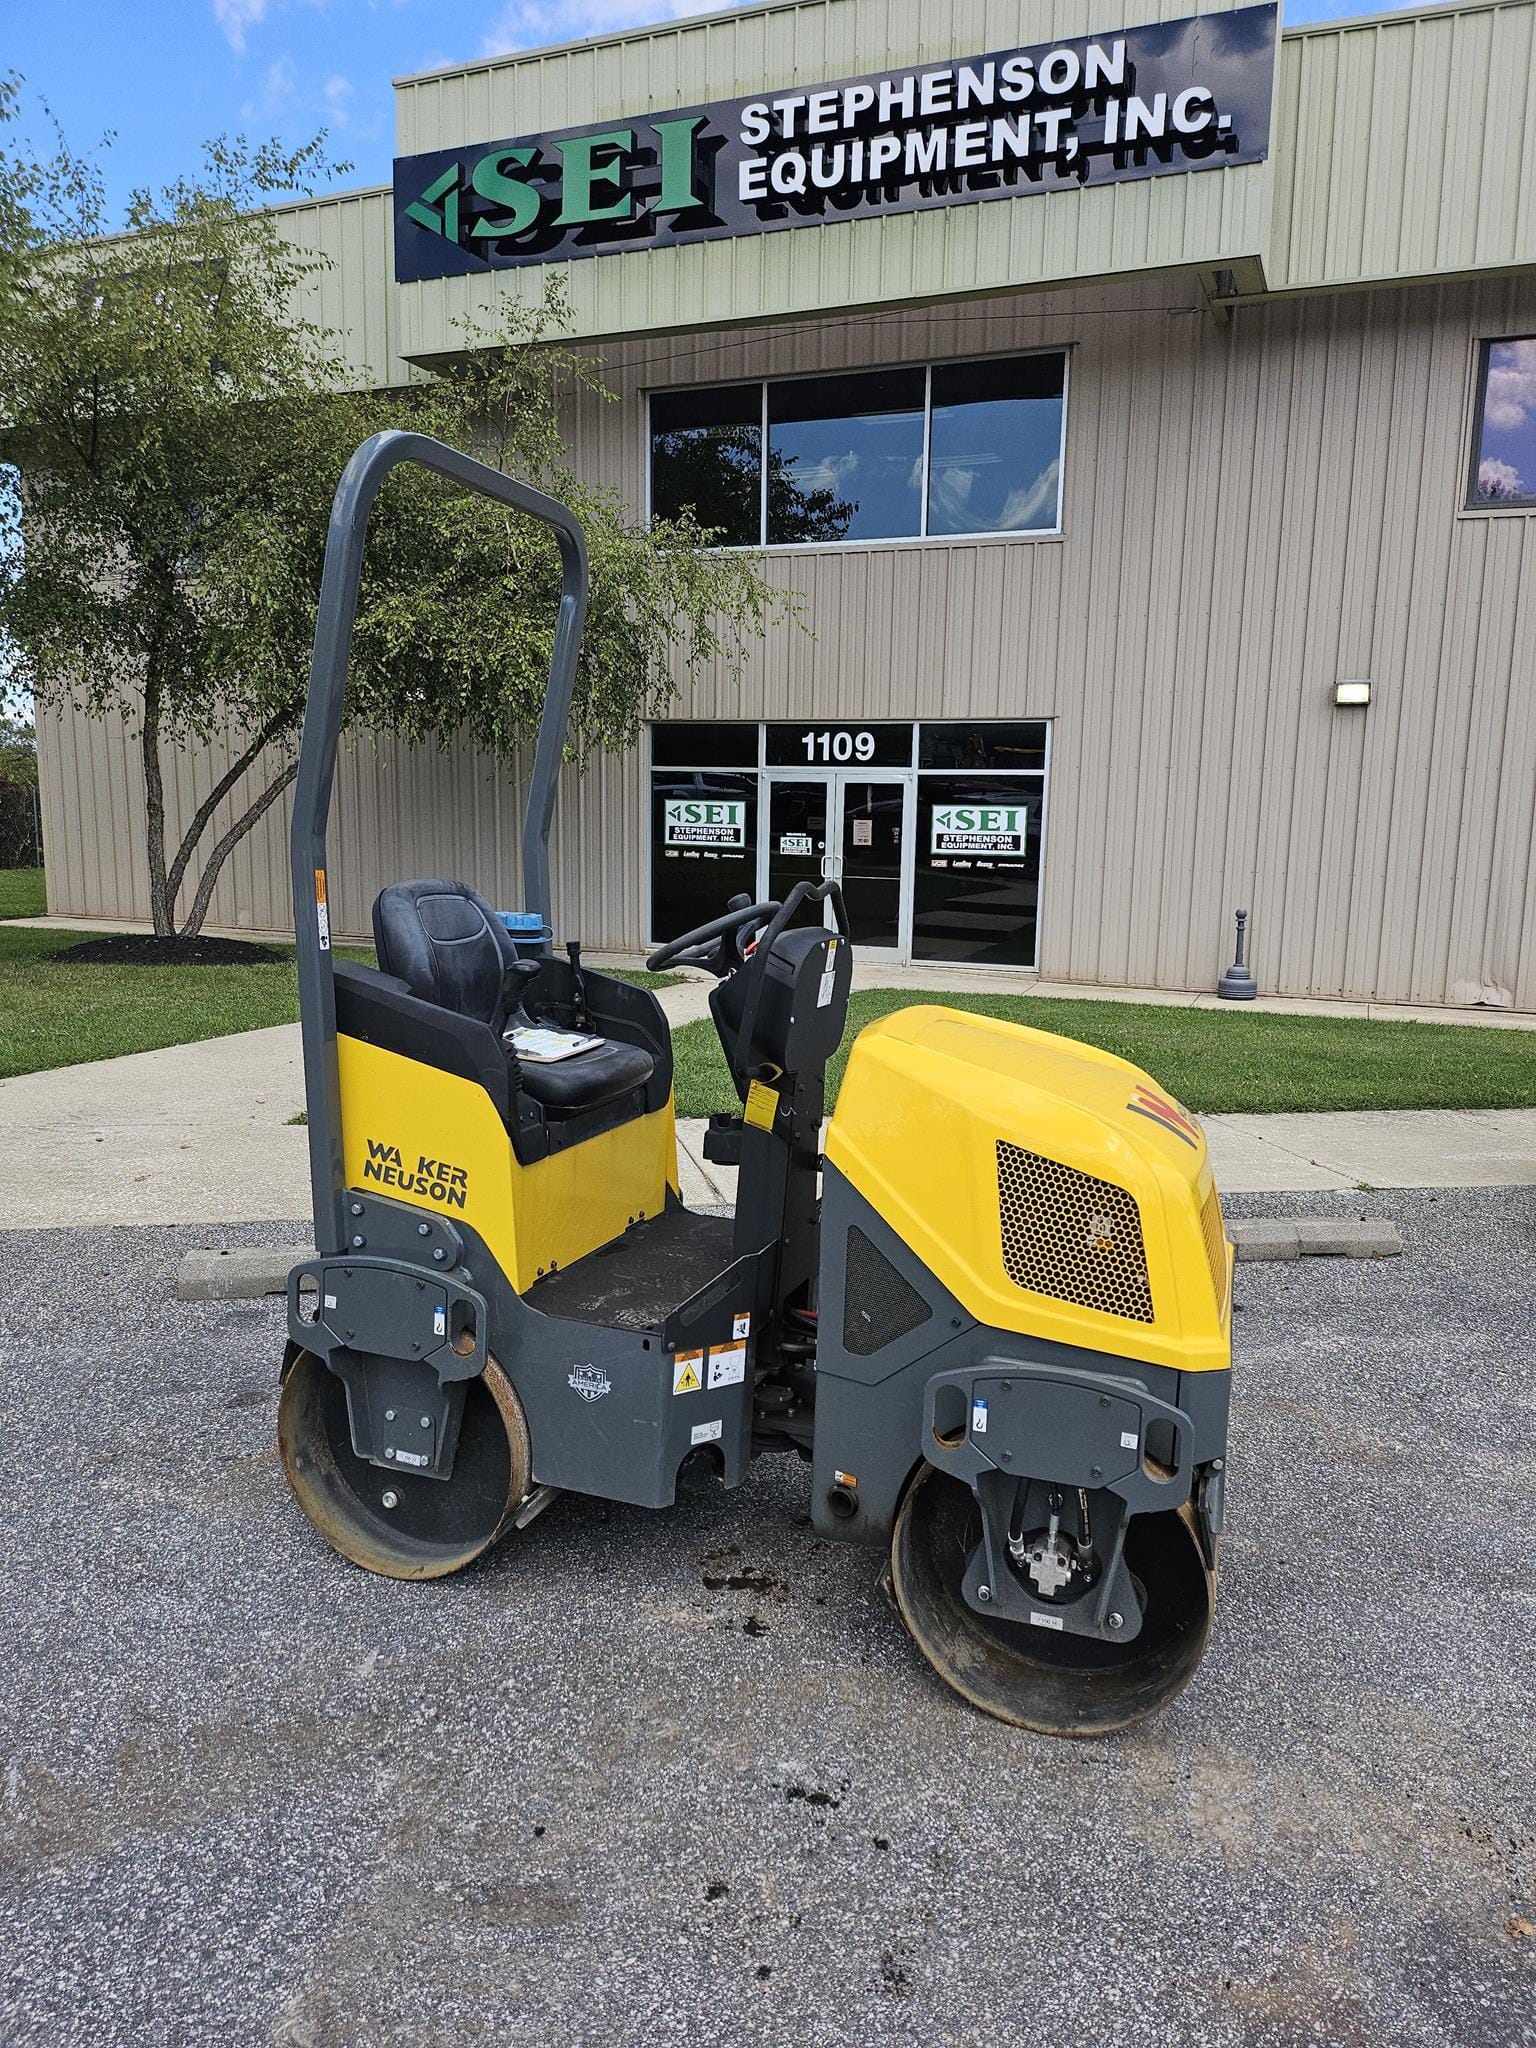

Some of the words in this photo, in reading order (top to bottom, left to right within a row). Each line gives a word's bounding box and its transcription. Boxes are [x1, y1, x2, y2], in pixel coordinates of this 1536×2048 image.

[740, 39, 1126, 145] STEPHENSON
[738, 107, 1079, 201] EQUIPMENT,
[1104, 86, 1232, 145] INC.
[470, 115, 704, 237] SEI
[801, 731, 875, 761] 1109
[684, 803, 739, 825] SEI
[955, 809, 1019, 831] SEI
[673, 834, 719, 842] EQUIPMENT,
[674, 827, 734, 836] STEPHENSON
[788, 838, 809, 847] SEI
[943, 834, 1013, 843] STEPHENSON
[941, 842, 995, 850] EQUIPMENT,
[363, 1159, 467, 1209] NEUSON
